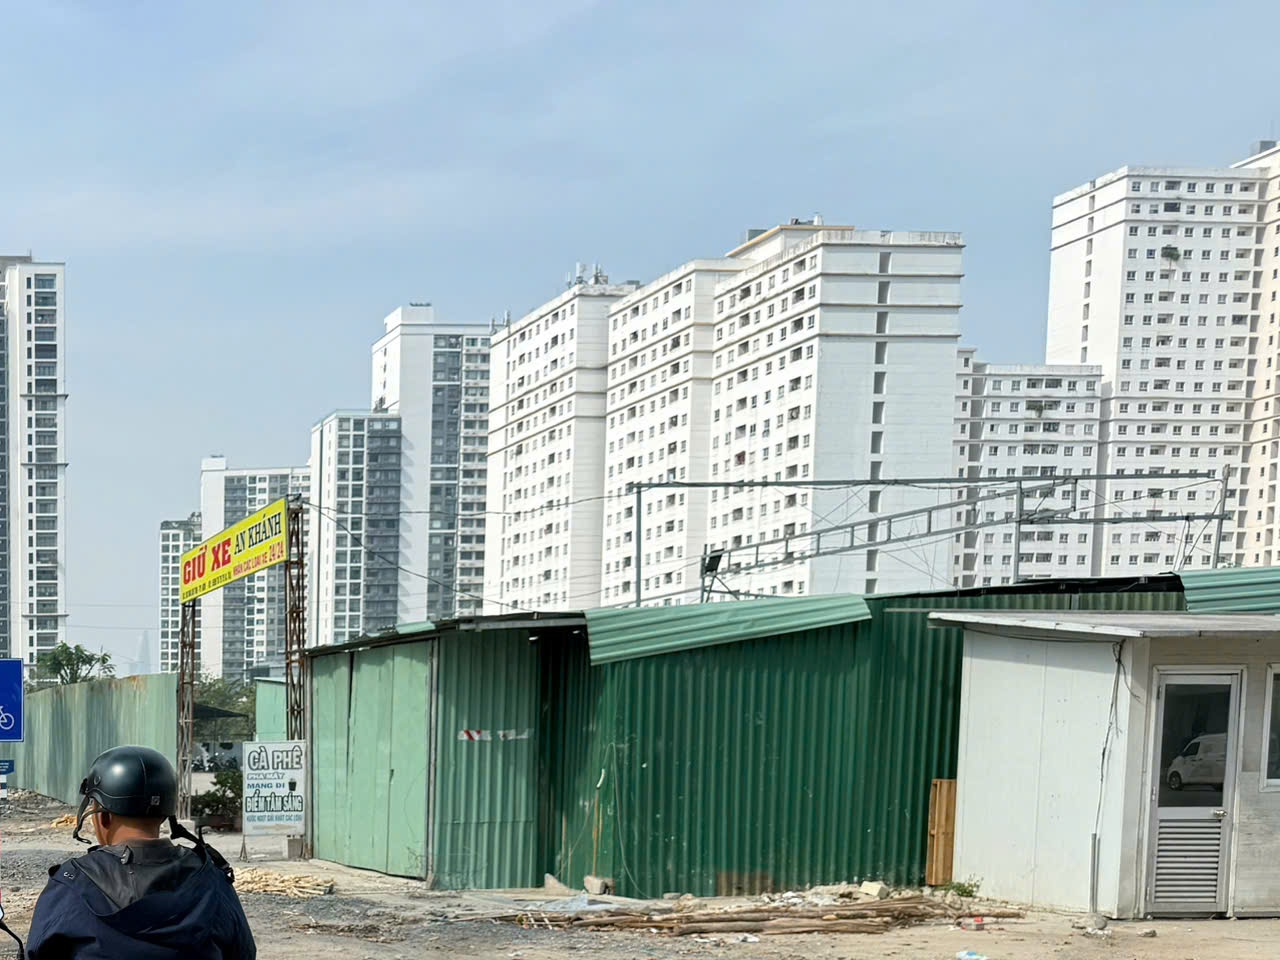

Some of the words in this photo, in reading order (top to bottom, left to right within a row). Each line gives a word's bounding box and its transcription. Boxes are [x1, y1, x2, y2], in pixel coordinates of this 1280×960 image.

[183, 545, 207, 585] GIỮ
[211, 537, 231, 572] XE
[234, 530, 246, 555] AN
[248, 512, 282, 548] KHÁNH
[269, 541, 284, 562] 24/24
[248, 745, 269, 771] CÀ
[272, 745, 303, 770] PHÊ
